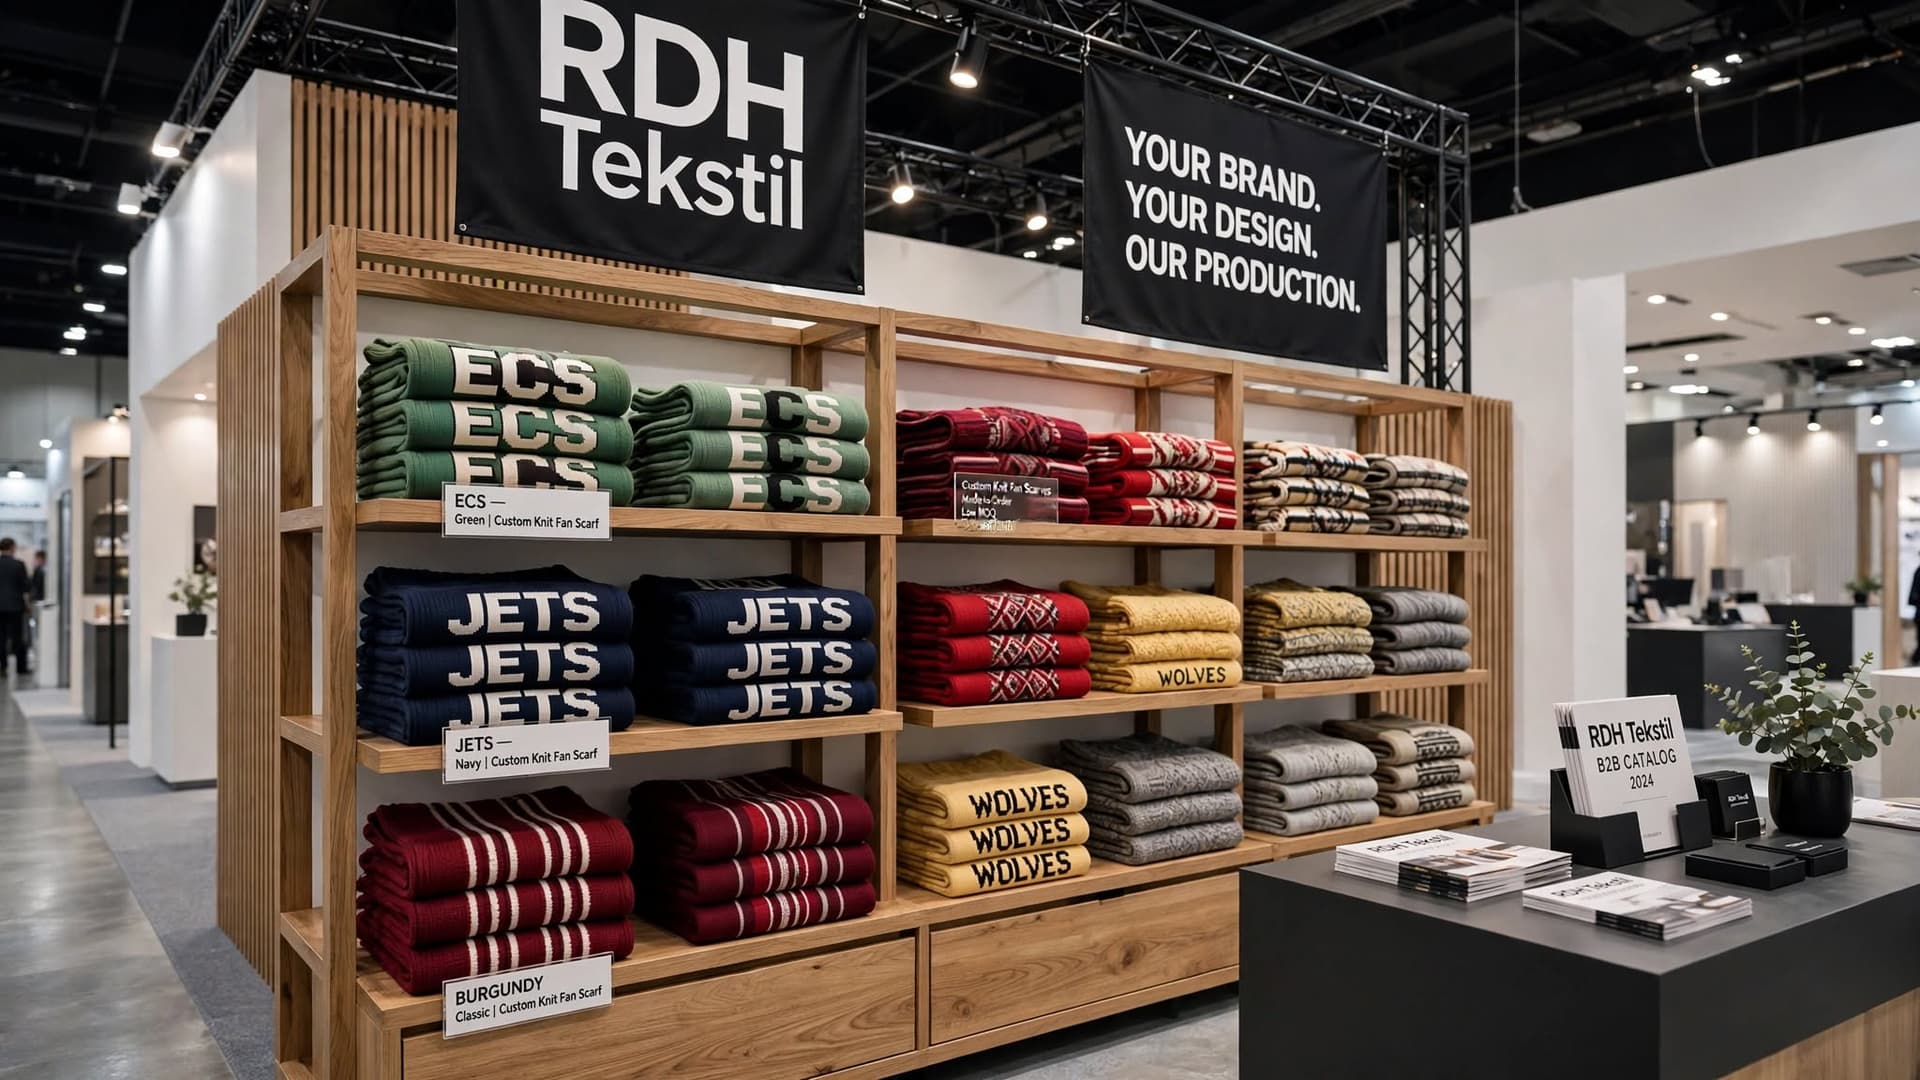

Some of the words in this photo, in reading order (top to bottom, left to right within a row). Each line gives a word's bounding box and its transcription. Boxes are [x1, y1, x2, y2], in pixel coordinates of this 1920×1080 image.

[540, 0, 804, 153] RDH
[540, 108, 803, 230] Tekstil
[1125, 126, 1211, 185] YOUR
[1219, 152, 1321, 213] BRAND.
[1125, 180, 1208, 234] YOUR
[1215, 202, 1318, 259] DESIGN.
[1125, 235, 1188, 280] OUR
[1195, 248, 1361, 313] PRODUCTION.
[449, 346, 597, 406] ECS
[450, 401, 598, 454] ECS
[726, 387, 842, 435] ECS
[450, 451, 599, 491] ECS
[727, 431, 843, 474] ECS
[455, 494, 486, 508] ECS
[728, 472, 843, 513] ECS
[455, 514, 485, 525] Green
[494, 515, 532, 527] Custom
[534, 516, 553, 527] Knit
[556, 517, 573, 528] Fan
[575, 518, 600, 529] Scarf
[448, 591, 600, 636] JETS
[727, 597, 852, 634] JETS
[448, 642, 601, 686] JETS
[727, 641, 853, 680] JETS
[1157, 666, 1226, 687] WOLVES
[449, 688, 600, 729] JETS
[727, 680, 853, 721] JETS
[455, 736, 493, 752] JETS
[1588, 722, 1625, 748] RDH
[1626, 717, 1674, 743] Tekstil
[455, 758, 481, 771] Navy
[491, 754, 529, 767] Custom
[532, 751, 551, 764] Knit
[554, 751, 571, 762] Fan
[573, 748, 598, 760] Scarf
[1597, 755, 1620, 773] B2B
[1623, 748, 1677, 769] CATALOG
[1630, 774, 1654, 789] 2024
[968, 784, 1070, 819] WOLVES
[969, 818, 1071, 854] WOLVES
[971, 850, 1071, 888] WOLVES
[455, 975, 544, 1006] BURGUNDY
[455, 1007, 490, 1023] Classic
[499, 999, 536, 1015] Custom
[538, 993, 558, 1007] Knit
[559, 991, 577, 1003] Fan
[578, 985, 602, 1000] Scarf
